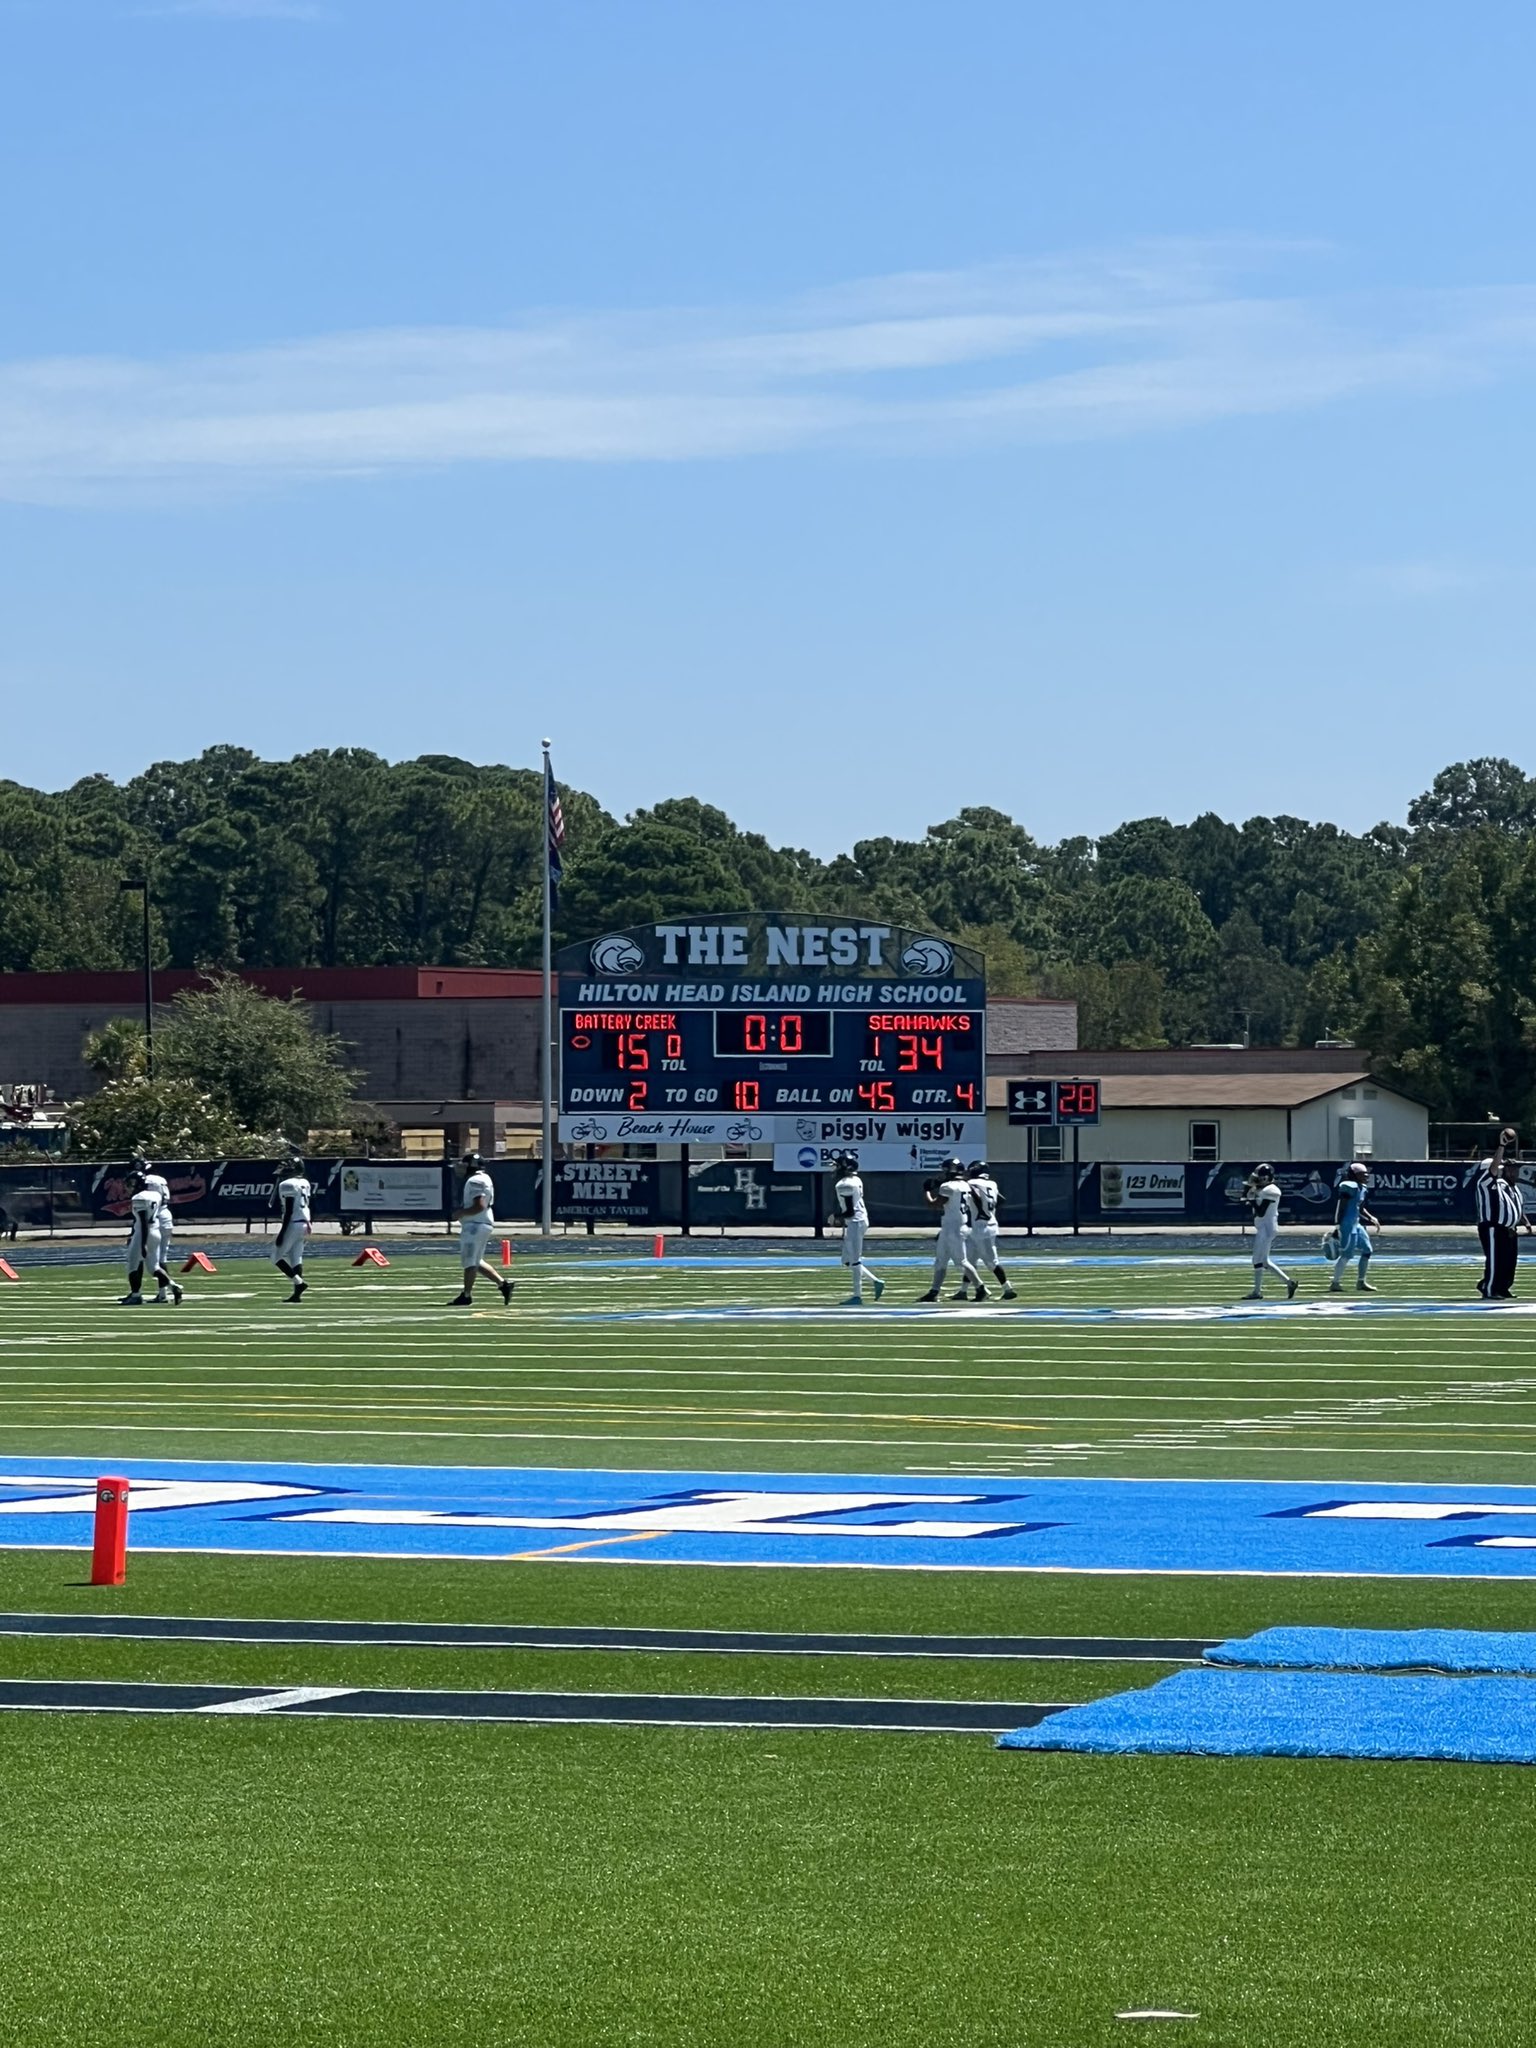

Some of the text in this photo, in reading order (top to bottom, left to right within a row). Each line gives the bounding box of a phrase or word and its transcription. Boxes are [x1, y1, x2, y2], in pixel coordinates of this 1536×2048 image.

[655, 925, 890, 966] THE NEST
[578, 984, 967, 1004] HILTON HEAD ISLAND HIGH SCHOOL
[575, 1014, 676, 1030] BATTERY CREEK
[869, 1015, 971, 1031] SEAHAWKS
[618, 1034, 649, 1070] 15
[898, 1035, 943, 1071] 34
[661, 1059, 687, 1071] TOL
[859, 1060, 886, 1072] TOL
[570, 1089, 624, 1103] DOWN
[629, 1081, 648, 1110] 2
[665, 1089, 718, 1103] TO GO
[735, 1081, 759, 1110] 10
[776, 1089, 854, 1103] BALL ON
[858, 1081, 895, 1110] 45
[912, 1089, 952, 1104] QTR.
[957, 1082, 974, 1110] 4
[1060, 1084, 1096, 1113] 28
[617, 1117, 716, 1137] Beach House
[821, 1118, 964, 1141] piggly wiggly
[563, 1163, 641, 1181] STREET
[1126, 1175, 1146, 1188] 123
[1374, 1174, 1457, 1190] PALMETTO
[572, 1182, 632, 1200] MEET
